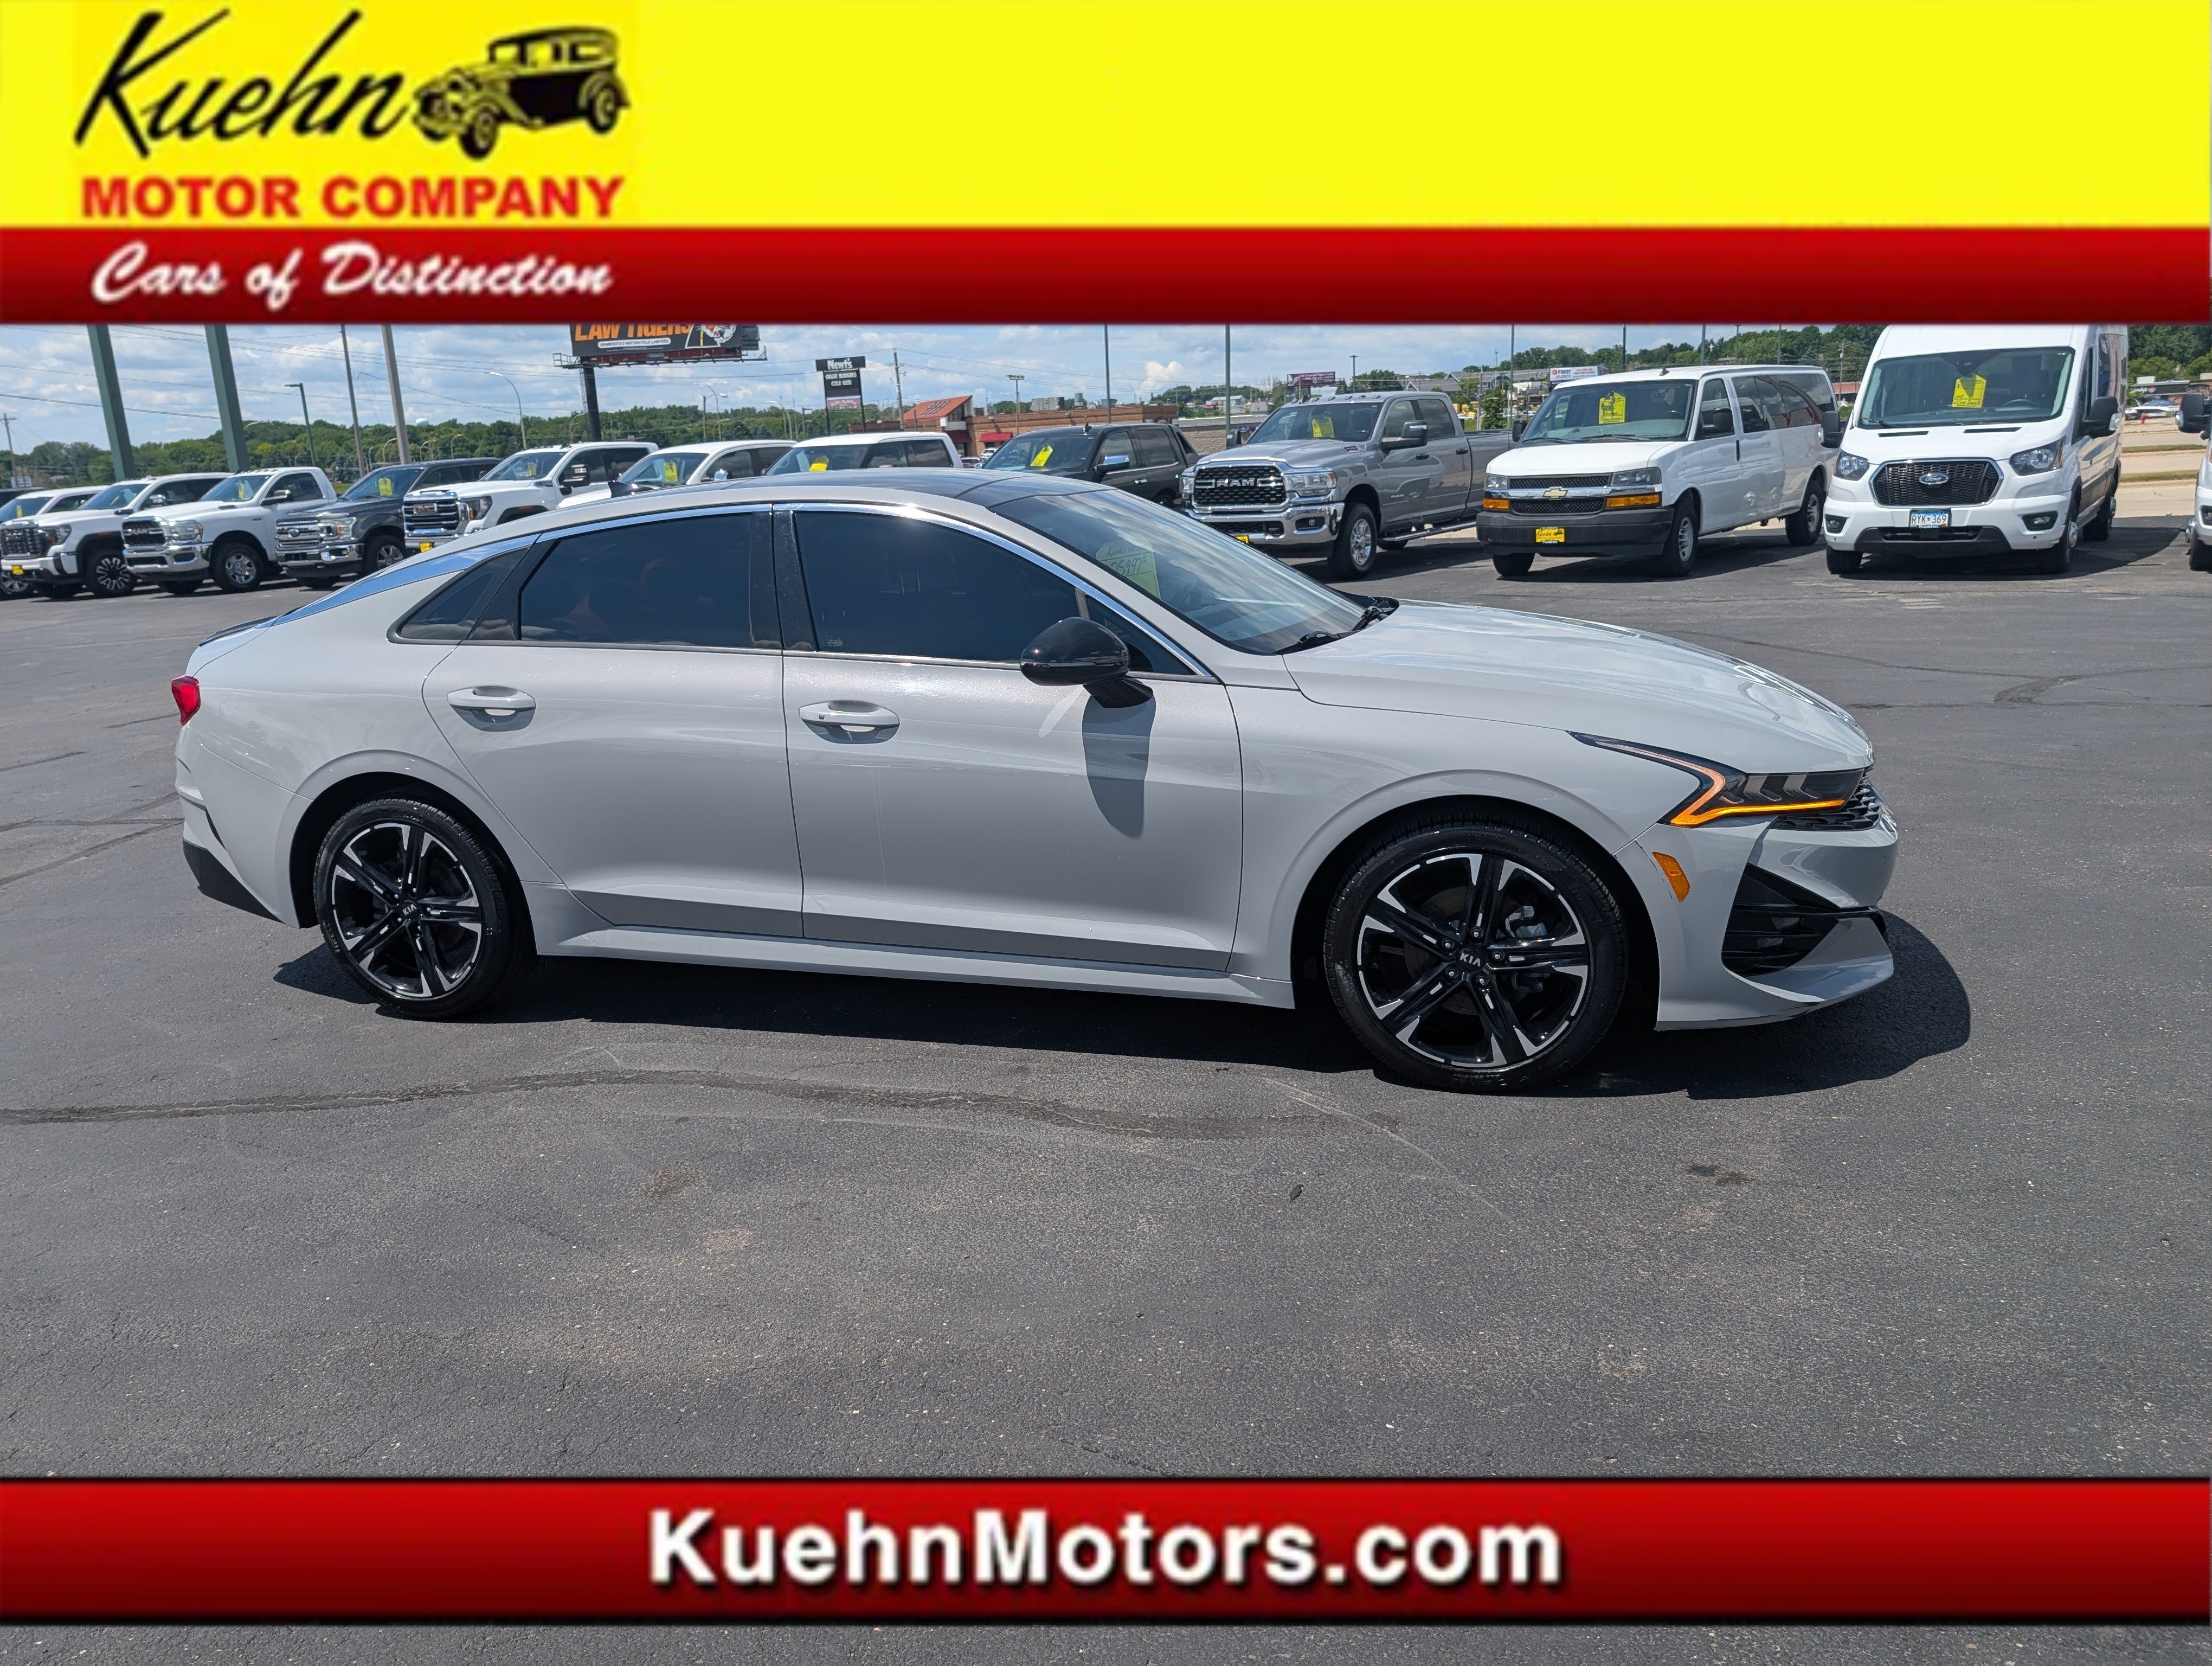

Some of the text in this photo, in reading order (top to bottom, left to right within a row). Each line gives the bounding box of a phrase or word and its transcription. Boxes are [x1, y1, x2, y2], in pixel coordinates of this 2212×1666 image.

[575, 323, 620, 341] LAW
[827, 357, 853, 369] Newt's
[1216, 478, 1255, 488] RAM
[1912, 515, 1947, 524] RYK 369
[402, 904, 417, 916] KIA
[1459, 952, 1481, 967] KIA
